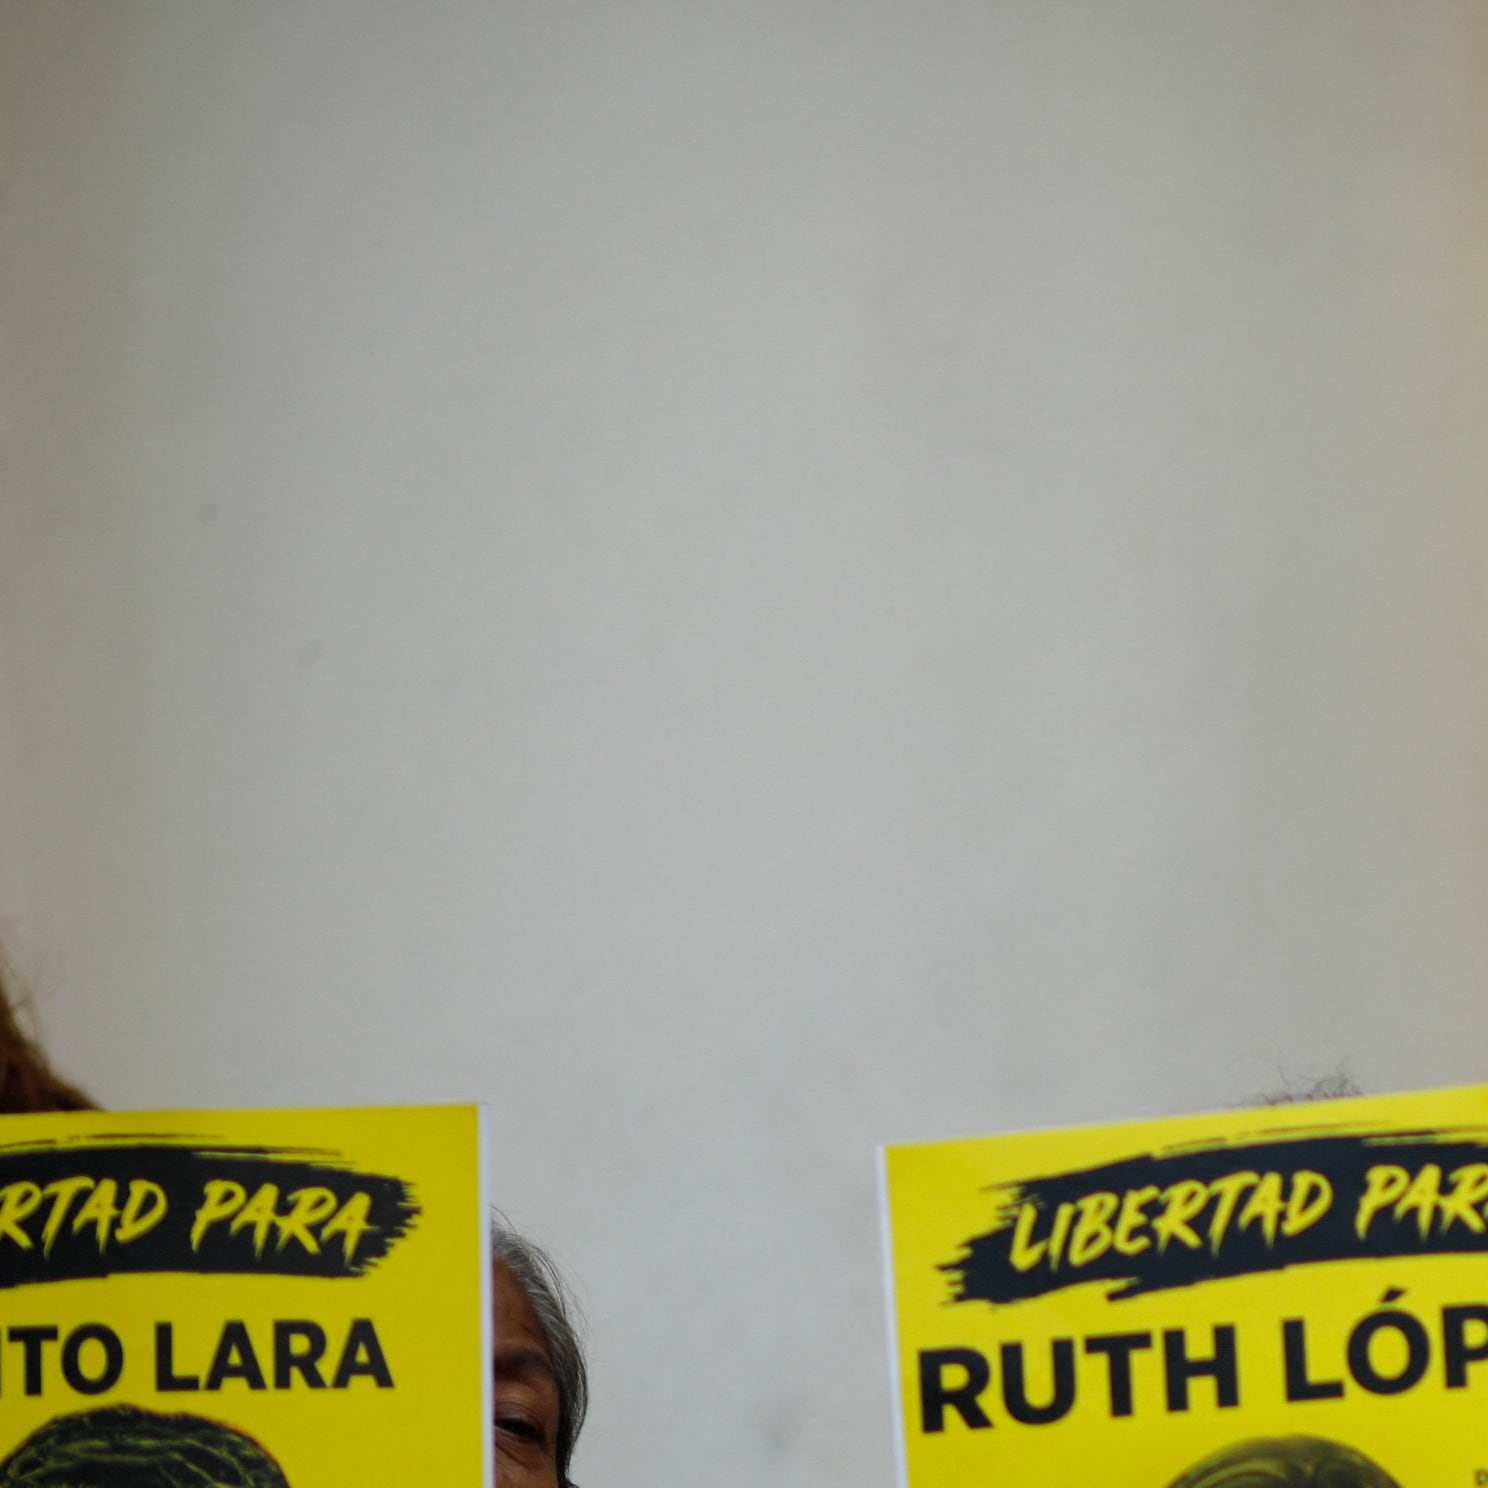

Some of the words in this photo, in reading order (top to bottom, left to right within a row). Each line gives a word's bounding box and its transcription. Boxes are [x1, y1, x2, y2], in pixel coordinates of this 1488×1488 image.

[190, 1179, 373, 1262] PARA
[1008, 1169, 1332, 1273] LIBERTAD
[0, 1322, 123, 1396] TO
[155, 1319, 395, 1393] LARA
[917, 1323, 1241, 1434] RUTH
